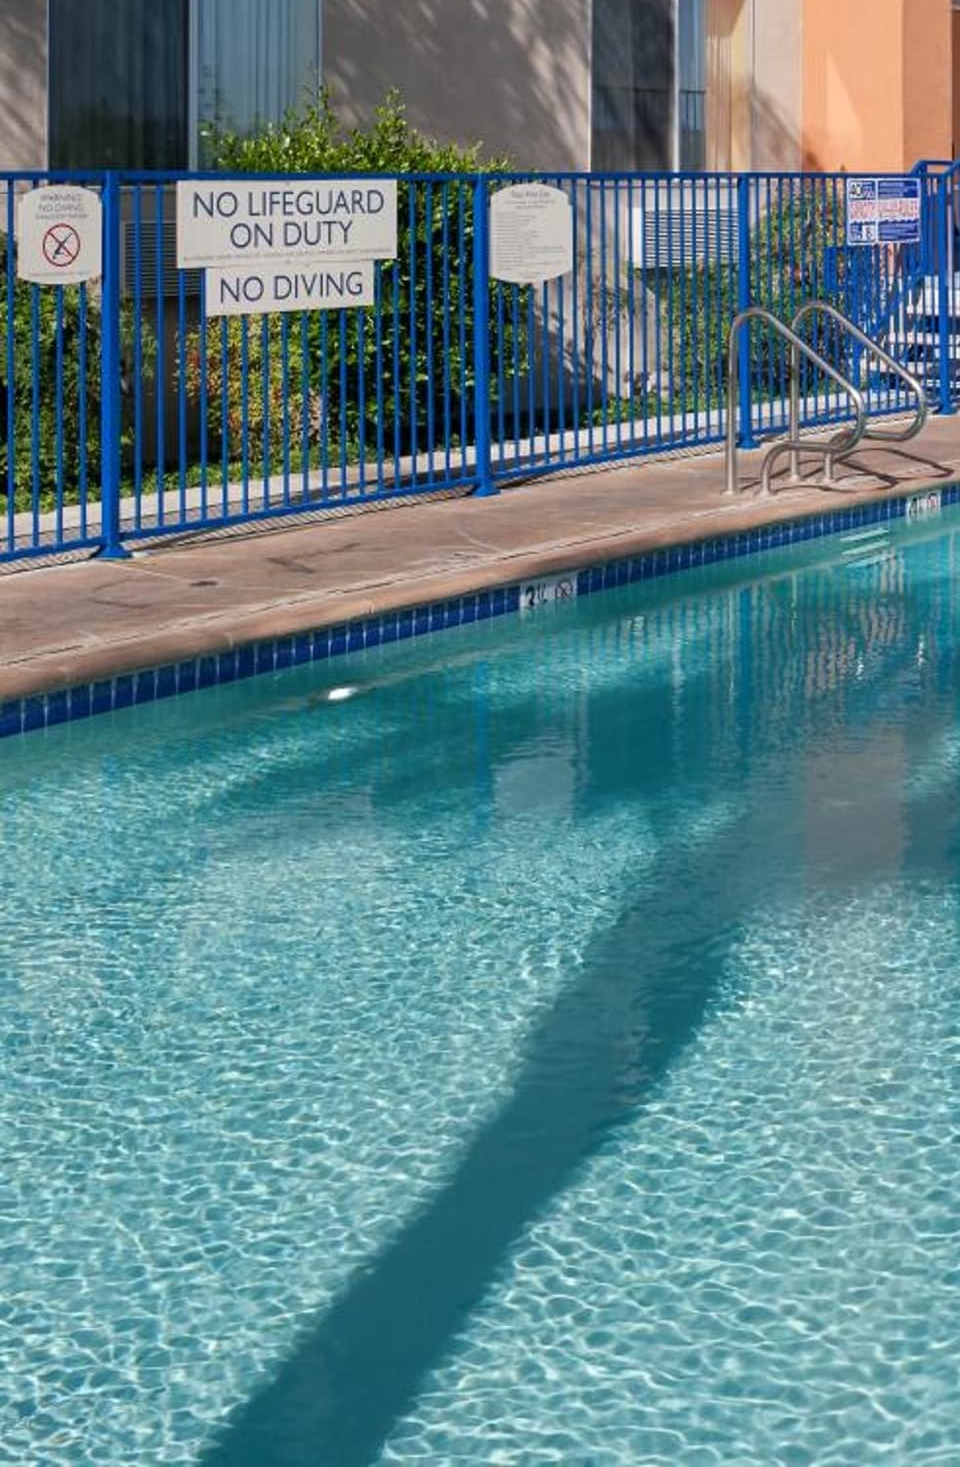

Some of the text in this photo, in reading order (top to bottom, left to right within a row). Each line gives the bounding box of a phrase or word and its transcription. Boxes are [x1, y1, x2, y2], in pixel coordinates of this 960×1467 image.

[193, 189, 385, 218] NO LIFEGUARD
[230, 220, 353, 249] ON DUTY
[220, 271, 363, 303] NO DIVING
